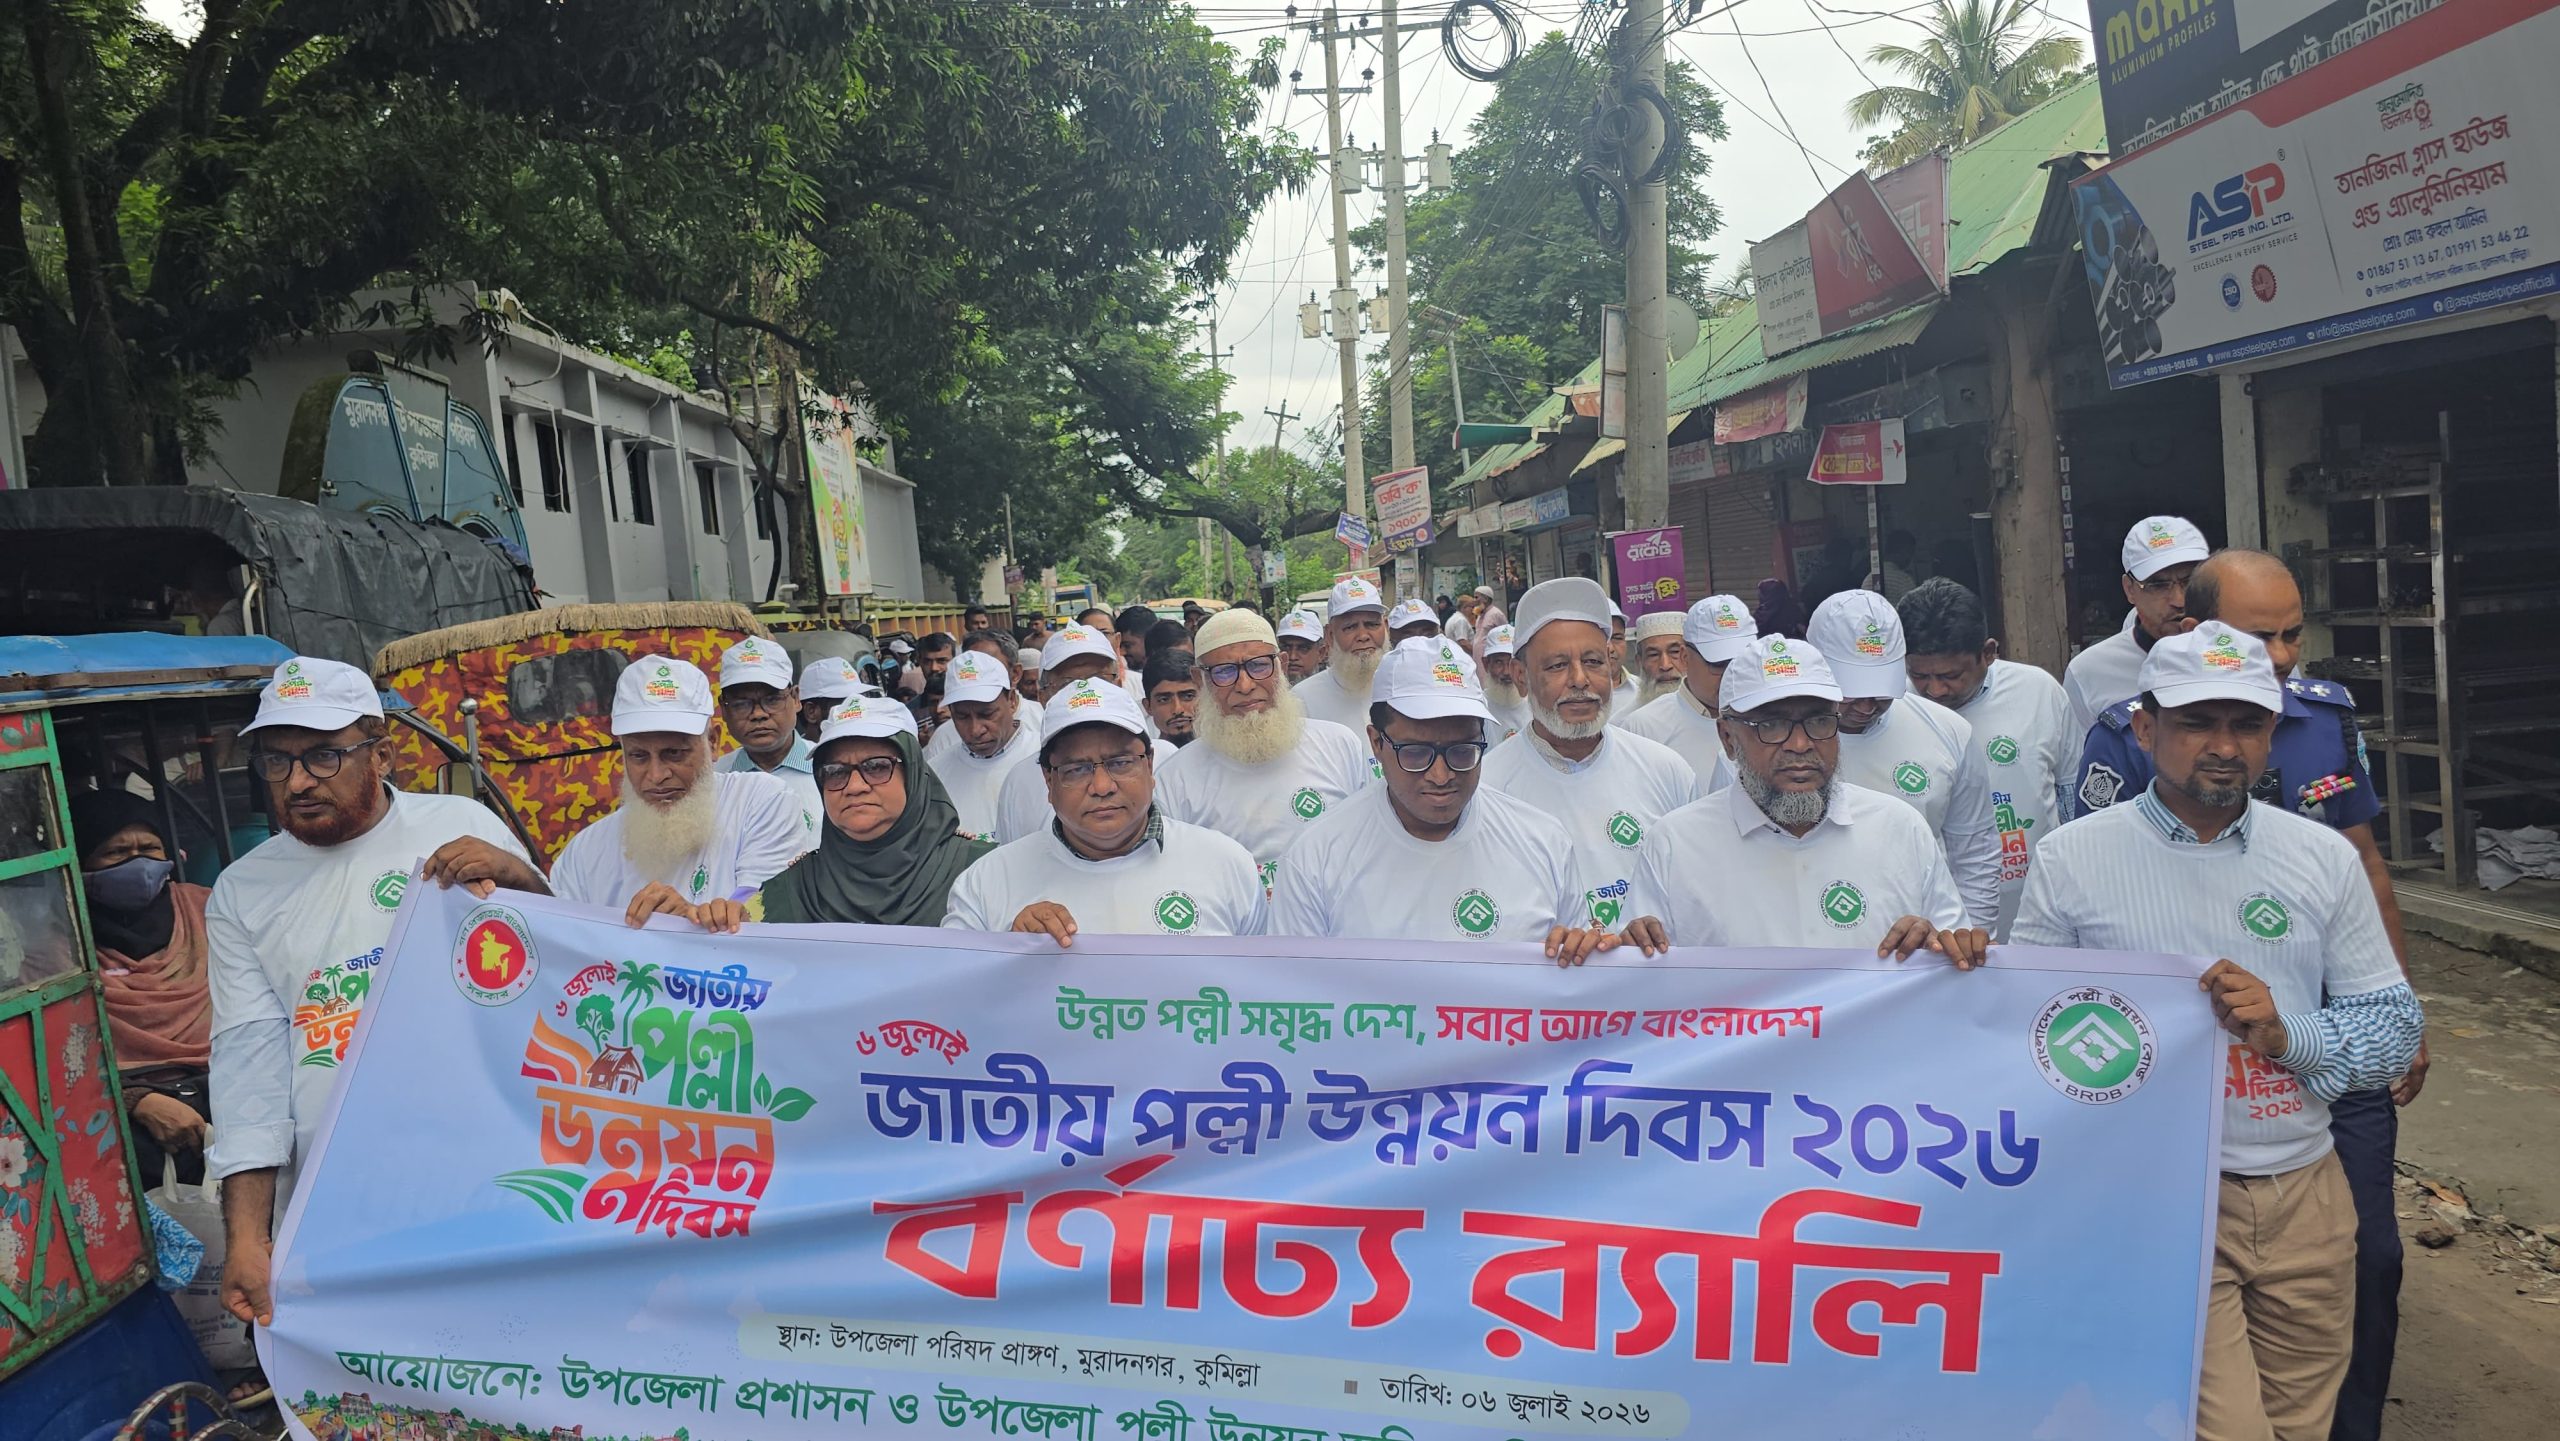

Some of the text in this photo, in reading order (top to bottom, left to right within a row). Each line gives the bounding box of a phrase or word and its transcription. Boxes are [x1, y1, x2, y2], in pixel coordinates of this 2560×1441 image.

[2111, 11, 2216, 85] ALUMINIUM PROFILES
[2335, 115, 2511, 194] তানজিনা গ্লাস হাউজ
[2189, 212, 2295, 254] STEEL PIPE IND. LTD.
[2353, 203, 2380, 229] এন্ড
[2453, 207, 2488, 230] আমিন
[2193, 232, 2298, 272] EXCELLENCE IN EVERY SERVICE
[2367, 262, 2395, 278] 01867
[2399, 257, 2410, 270] 51
[2413, 254, 2425, 267] 13
[2445, 239, 2477, 258] 01991
[2481, 234, 2495, 248] 53
[2497, 230, 2511, 243] 46
[2514, 225, 2529, 240] 22
[2444, 272, 2556, 311] @aspsteelpipeofficial
[2315, 307, 2416, 337] info@aspsteelpipe.com
[2214, 334, 2296, 362] www.aspsteelpipe.com
[343, 397, 390, 429] মুরাদনগর
[408, 442, 439, 471] কুমিল্লা
[1627, 540, 1672, 562] রকেট
[1655, 577, 1680, 599] ফ্রি
[563, 960, 618, 998] জুলাই
[664, 963, 772, 1012] জাতীয়
[855, 1019, 970, 1066] ৬ জুলাই
[1056, 985, 1824, 1054] উন্নত পল্লী সমৃদ্ধ দেশ, সবার আগে বাংলাদেশ
[2035, 1000, 2064, 1074] বাংলাদেশ
[2109, 993, 2150, 1036] উন্নয়ন
[2135, 1043, 2153, 1084] বোর্ড
[631, 1006, 754, 1115] পল্লী
[2065, 1084, 2122, 1102] BRDB
[2248, 1096, 2303, 1121] ২০২৬
[859, 1052, 2041, 1191] জাতীয় পল্লী উন্নয়ন দিবস ২০২৬
[536, 1085, 775, 1224] উন্নয়ন
[635, 1178, 758, 1239] দিবস
[872, 1153, 1425, 1329] বর্ণাঢ্য
[777, 1323, 822, 1351] স্থান:
[829, 1323, 919, 1358] উপজেলা
[926, 1330, 996, 1363] পরিষদ
[1194, 1356, 1262, 1388] কুমিল্লা
[335, 1350, 543, 1400] আয়োজনে:
[557, 1353, 726, 1413] উপজেলা
[736, 1378, 876, 1426] প্রশাসন
[888, 1394, 919, 1425] ও
[934, 1382, 1104, 1441] উপজেলা
[1380, 1373, 1651, 1426] তারিখ: ০৬ জুলাই ২০২৬
